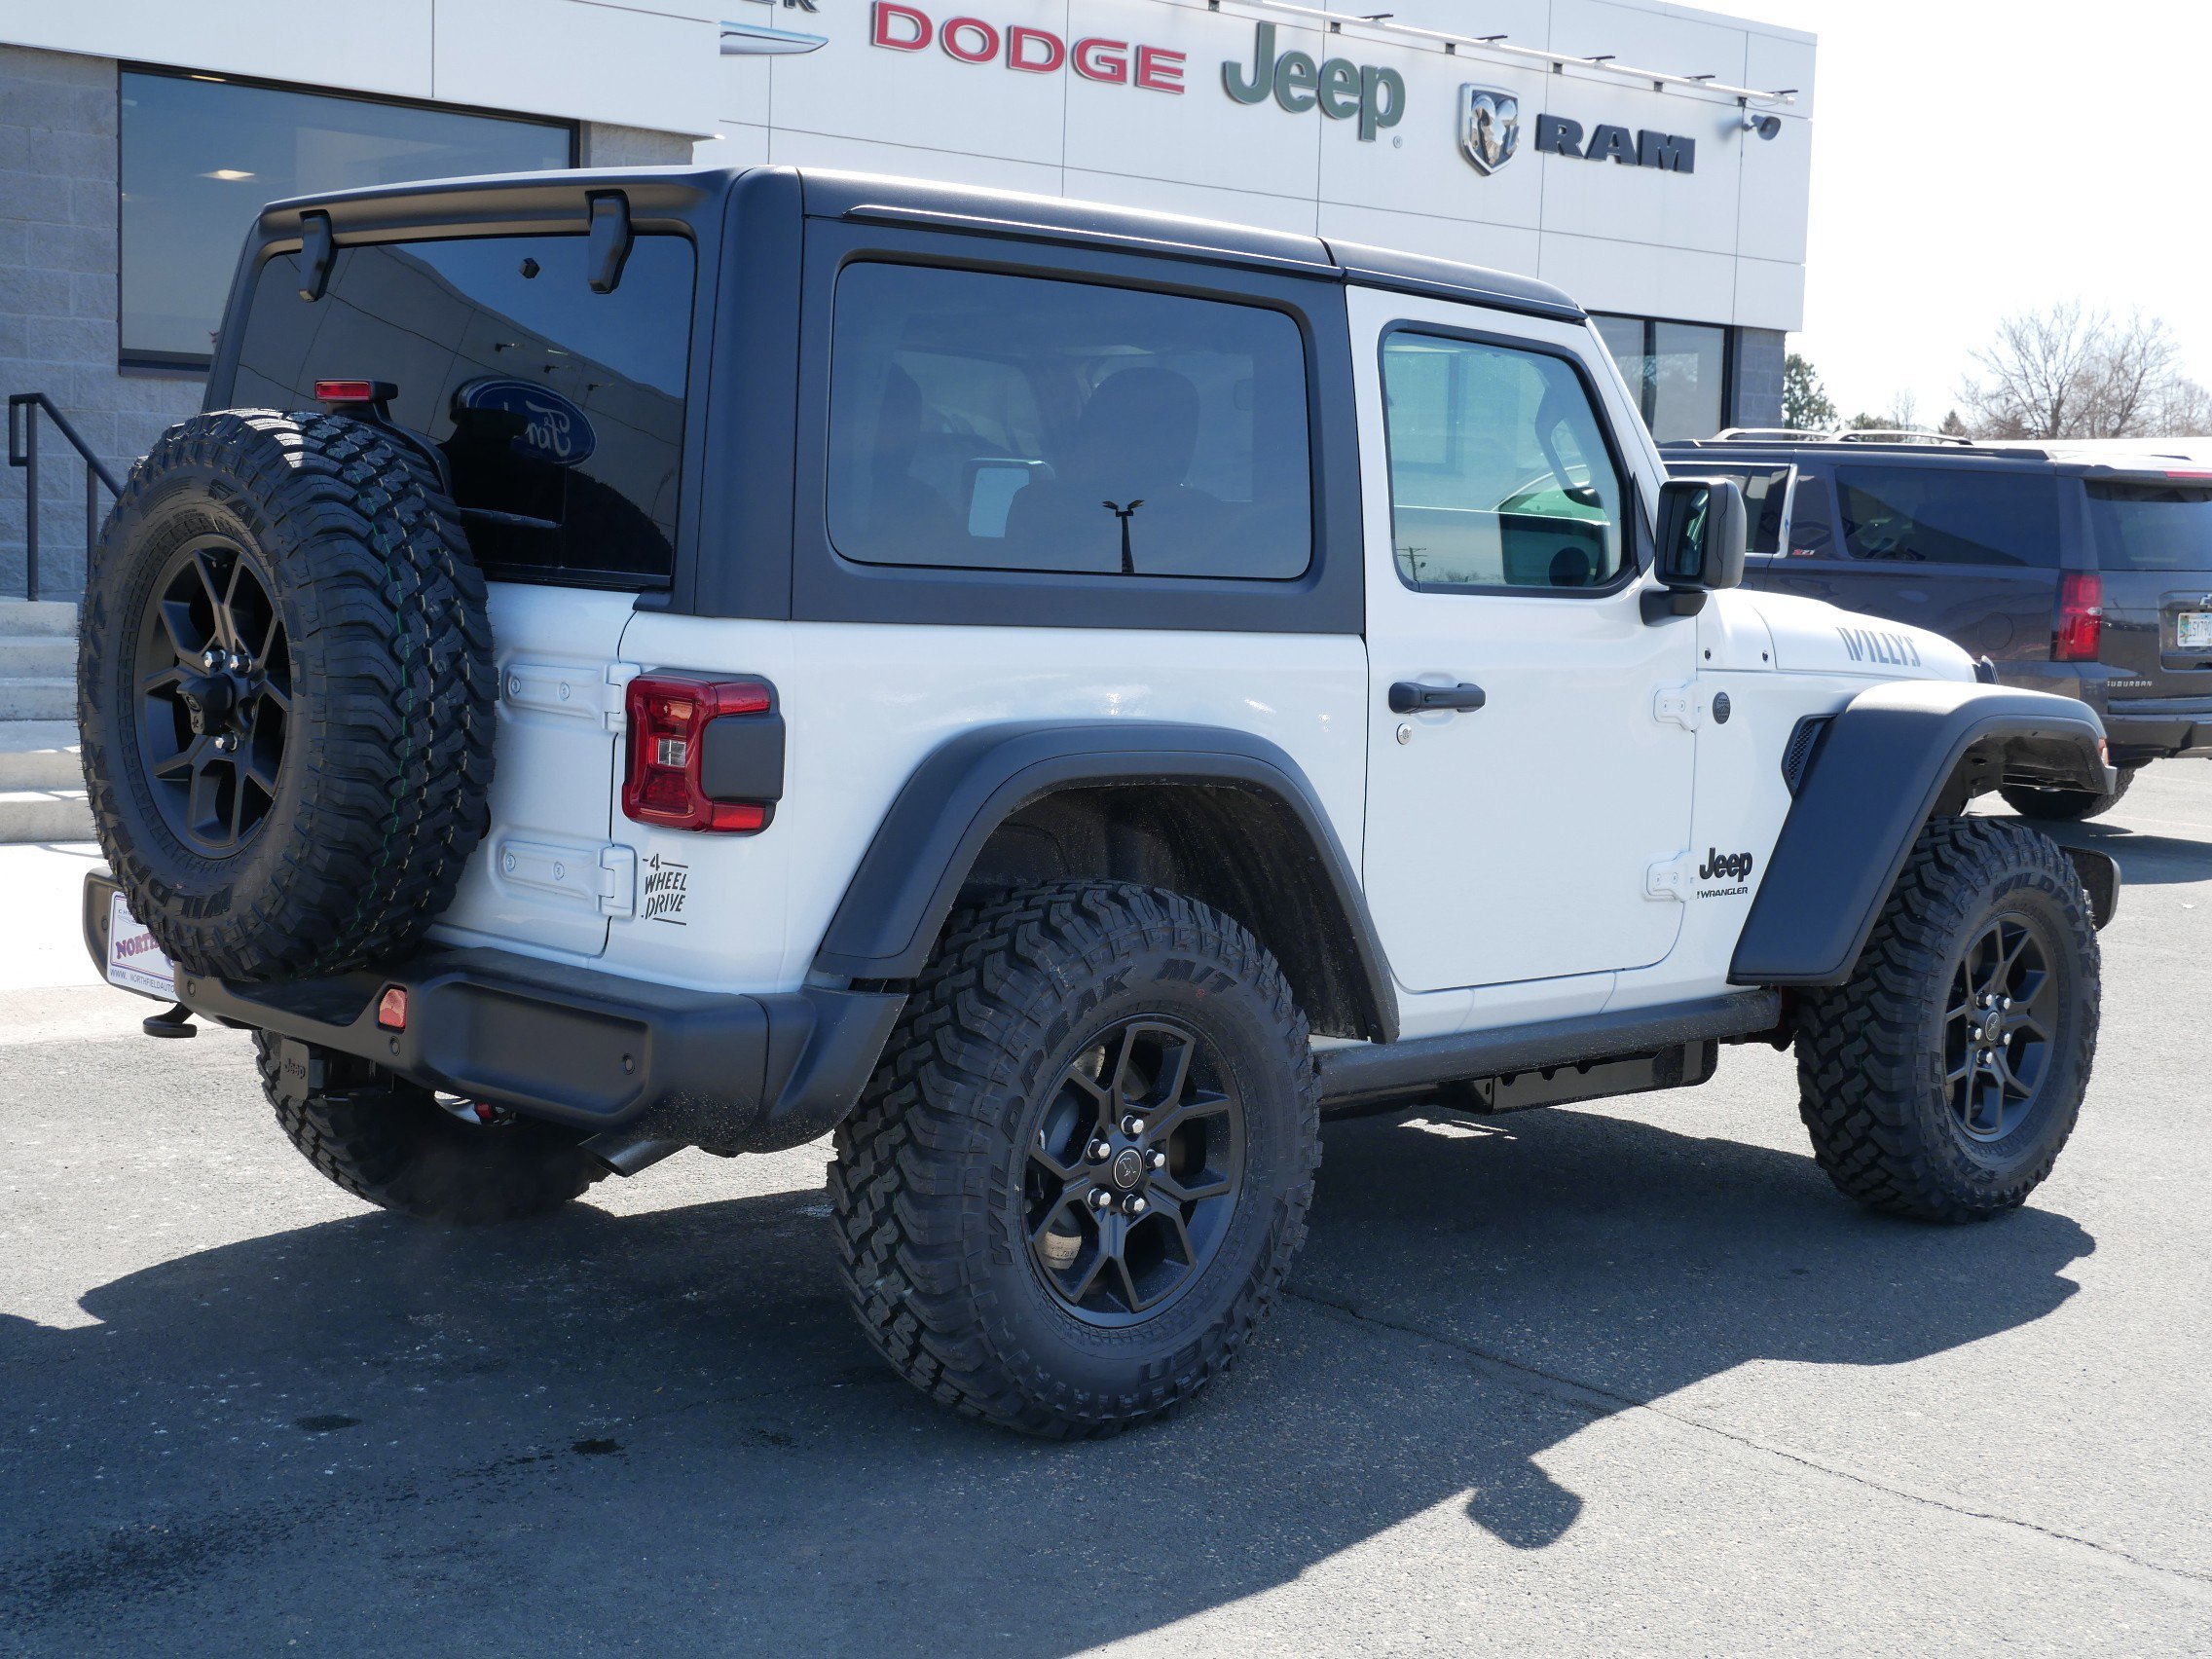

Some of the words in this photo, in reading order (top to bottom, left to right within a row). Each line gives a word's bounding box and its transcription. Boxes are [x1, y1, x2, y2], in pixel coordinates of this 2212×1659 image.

[869, 2, 1187, 94] DODGE
[1223, 22, 1406, 142] Jeep
[1535, 113, 1696, 174] RAM
[1835, 626, 1921, 667] WILLYS
[649, 853, 660, 871] 4
[1699, 847, 1753, 882] Jeep
[645, 871, 687, 895] WHEEL
[1700, 886, 1749, 899] WRANGLER
[645, 893, 686, 920] DRIVE
[115, 932, 160, 959] NORTH
[129, 974, 175, 993] NORTHFIELDAUTO
